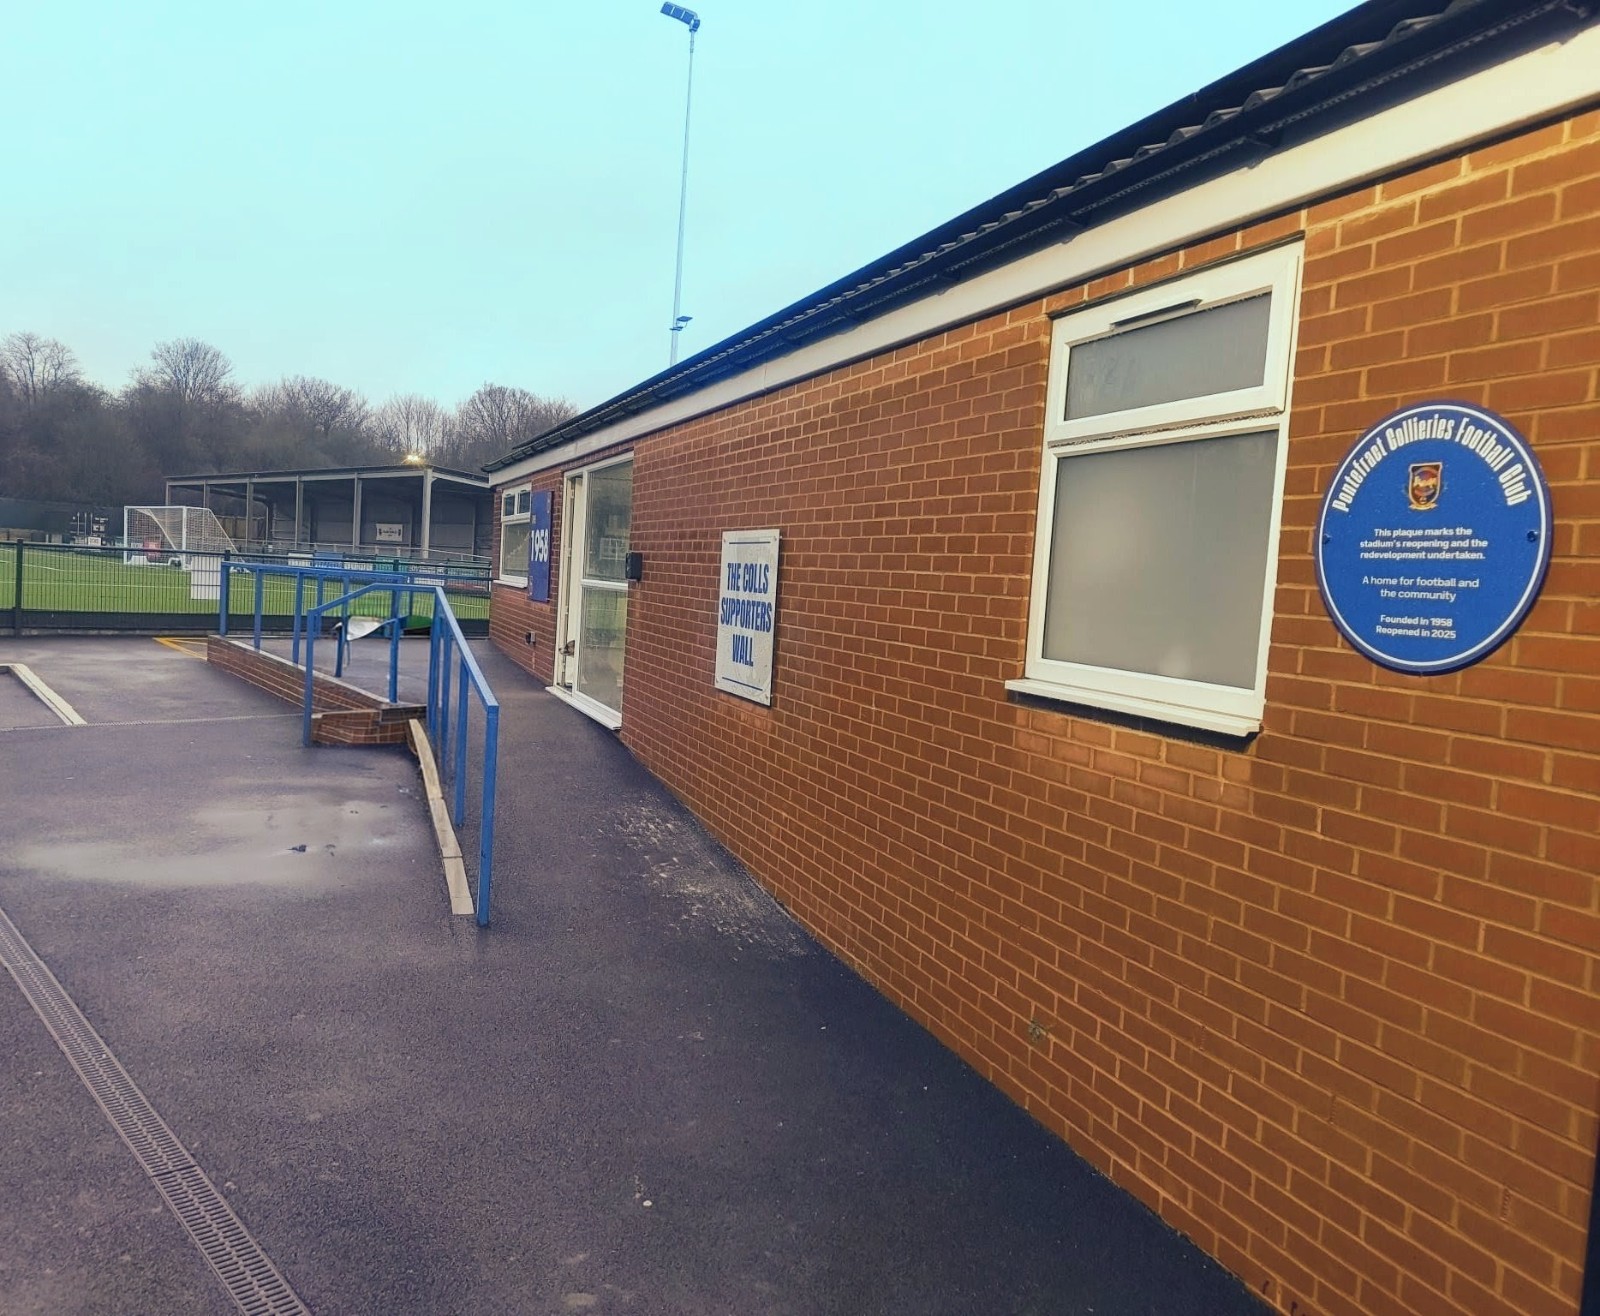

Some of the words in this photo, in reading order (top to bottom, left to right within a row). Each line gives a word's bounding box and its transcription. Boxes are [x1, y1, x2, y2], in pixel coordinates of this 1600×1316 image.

[1332, 437, 1388, 512] Pontefract
[1385, 413, 1455, 451] Collieries
[1454, 417, 1515, 472] Football
[1498, 463, 1532, 506] Club
[1374, 528, 1392, 537] This
[1392, 528, 1424, 538] plaque
[1424, 527, 1454, 536] marks
[1455, 527, 1473, 536] the
[531, 528, 549, 562] 1958
[1360, 539, 1401, 548] stadium's
[1402, 539, 1449, 549] reopening
[1450, 539, 1470, 548] and
[1471, 538, 1488, 547] the
[1360, 550, 1426, 560] redevelopment
[1427, 551, 1486, 560] undertaken.
[727, 562, 741, 592] THE
[743, 563, 769, 595] COLLS
[1362, 575, 1369, 585] A
[1370, 576, 1398, 585] home
[1399, 576, 1414, 586] for
[1416, 576, 1457, 587] football
[1457, 578, 1480, 588] and
[1380, 588, 1396, 598] the
[1398, 590, 1457, 602] community
[720, 597, 773, 633] SUPPORTERS
[1380, 614, 1419, 625] Founded
[1420, 616, 1429, 626] in
[1430, 617, 1453, 627] 1958
[1376, 625, 1420, 637] Reopened
[1421, 628, 1430, 637] in
[1431, 629, 1457, 639] 2025
[732, 633, 754, 667] WALL
